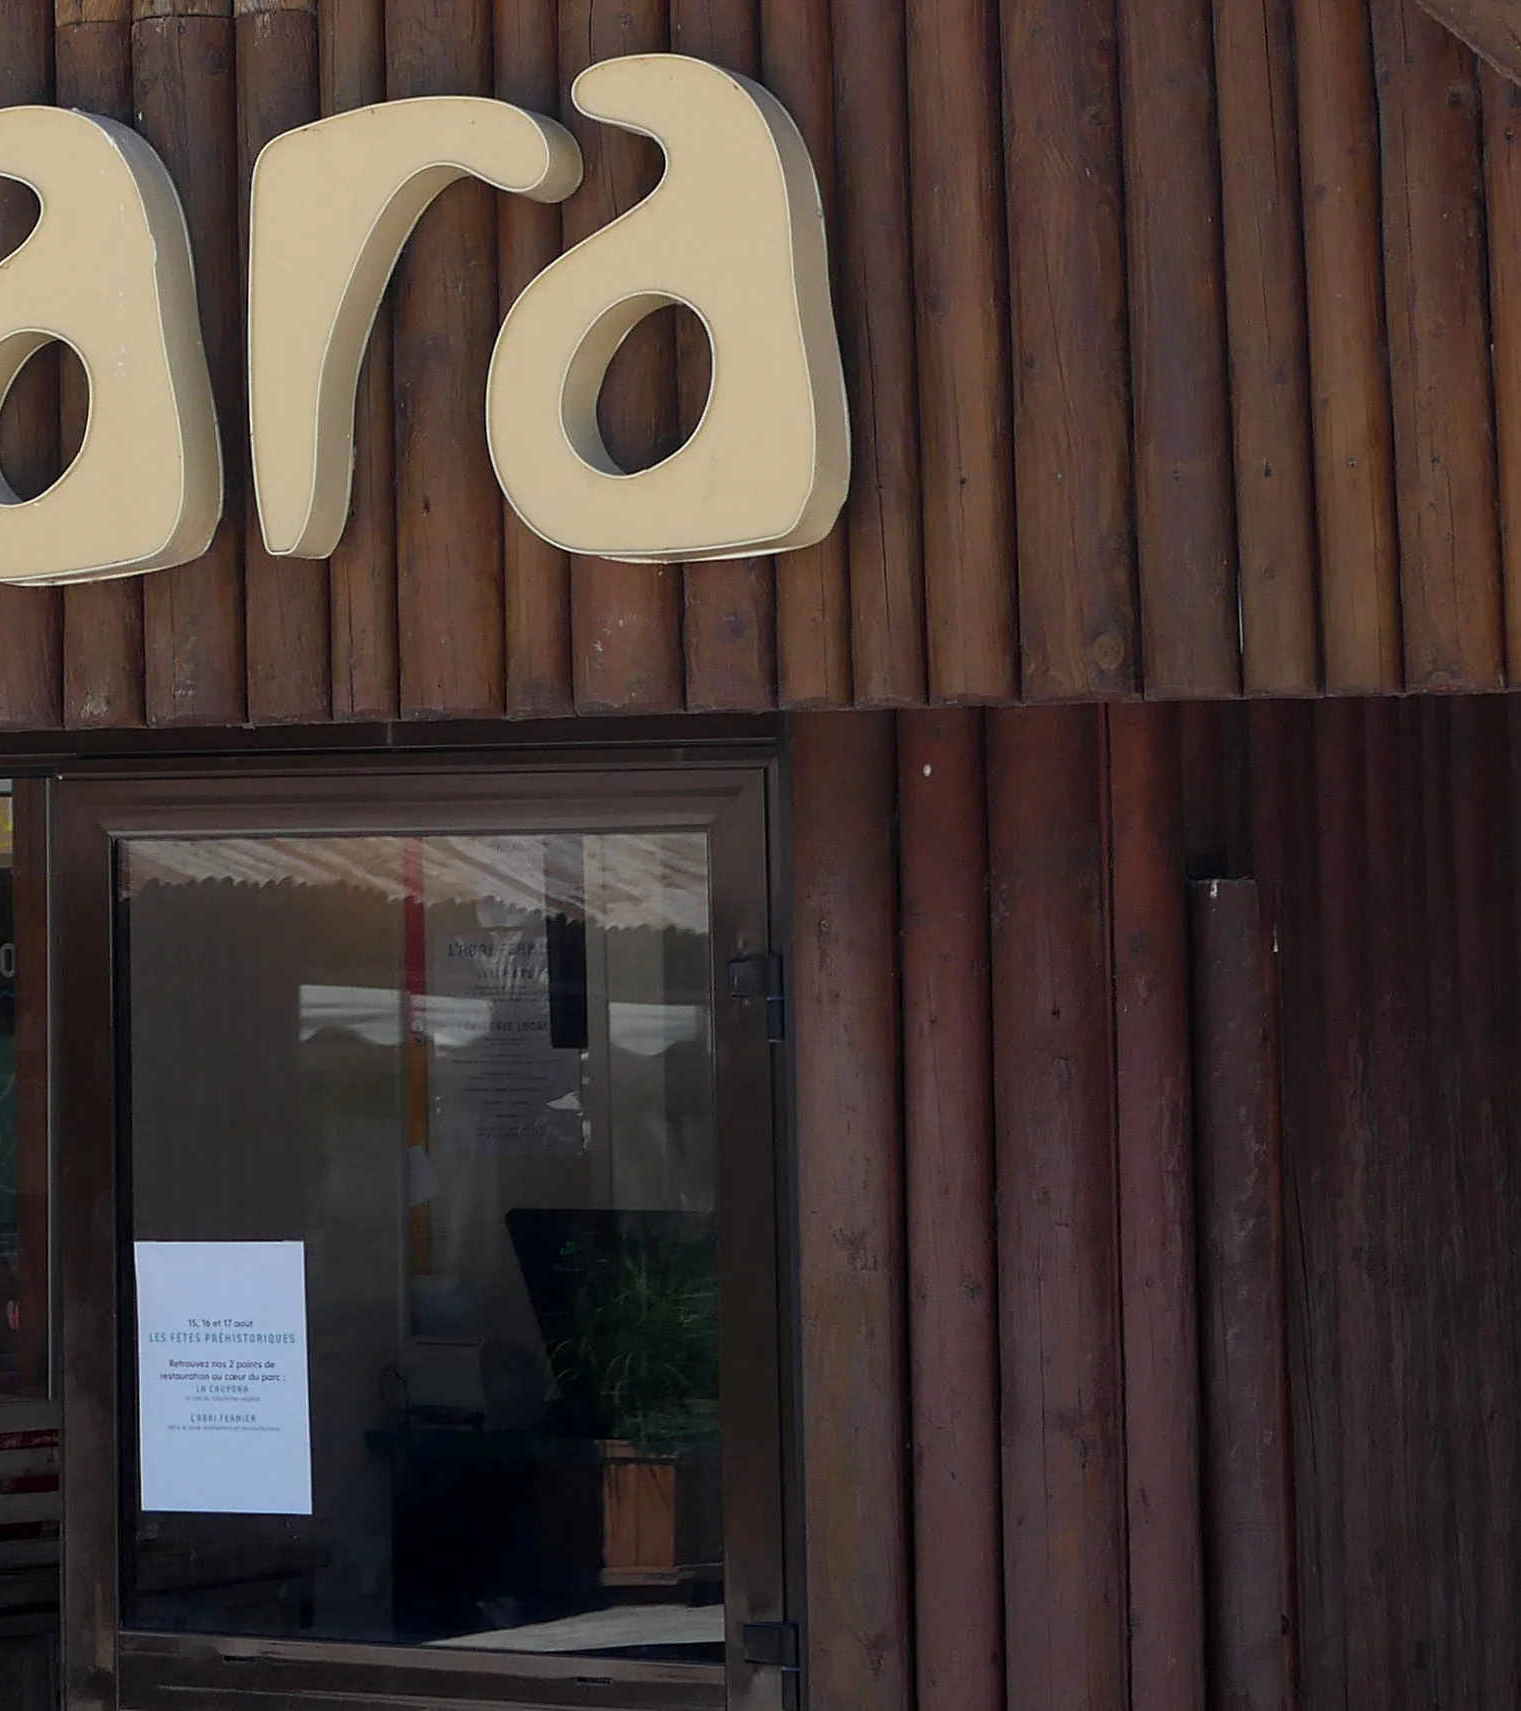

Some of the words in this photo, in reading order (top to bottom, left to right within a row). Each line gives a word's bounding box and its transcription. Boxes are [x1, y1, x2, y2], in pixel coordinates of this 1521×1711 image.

[188, 1318, 200, 1328] 15,
[201, 1319, 211, 1328] 16
[212, 1319, 221, 1327] et
[223, 1319, 232, 1327] 17
[233, 1319, 254, 1328] août
[148, 1332, 166, 1343] LES
[170, 1331, 201, 1344] FÊTES
[204, 1331, 296, 1345] PRÉHISTORIQUES
[168, 1359, 209, 1369] Retrouvez
[211, 1361, 227, 1369] nos
[236, 1360, 262, 1371] points
[264, 1360, 276, 1369] de
[160, 1372, 210, 1381] restauration
[248, 1373, 259, 1381] du
[261, 1374, 280, 1383] parc
[195, 1384, 206, 1393] LA
